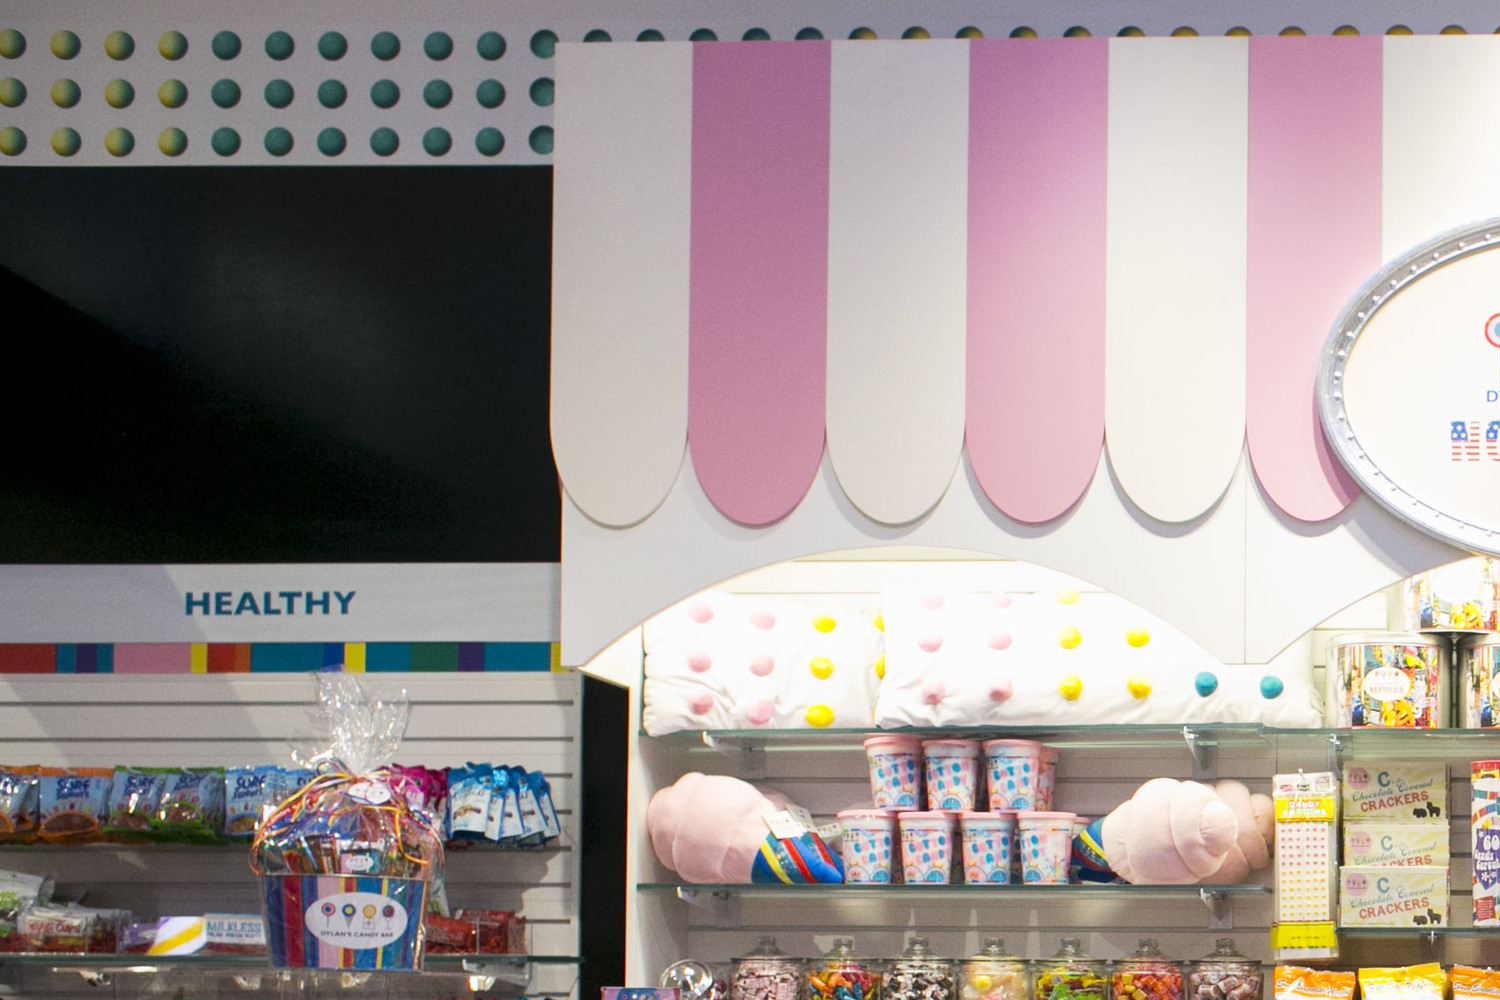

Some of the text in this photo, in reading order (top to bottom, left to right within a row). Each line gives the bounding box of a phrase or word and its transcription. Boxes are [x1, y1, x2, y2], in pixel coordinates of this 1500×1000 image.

[185, 591, 357, 616] HEALTHY
[1351, 778, 1434, 802] Chocolate Covered
[1360, 790, 1430, 812] CRACKERS
[1349, 883, 1435, 909] Chocolate Covered
[1359, 896, 1430, 920] CRACKERS
[206, 921, 261, 934] MILKLESS
[353, 930, 379, 938] CANDY
